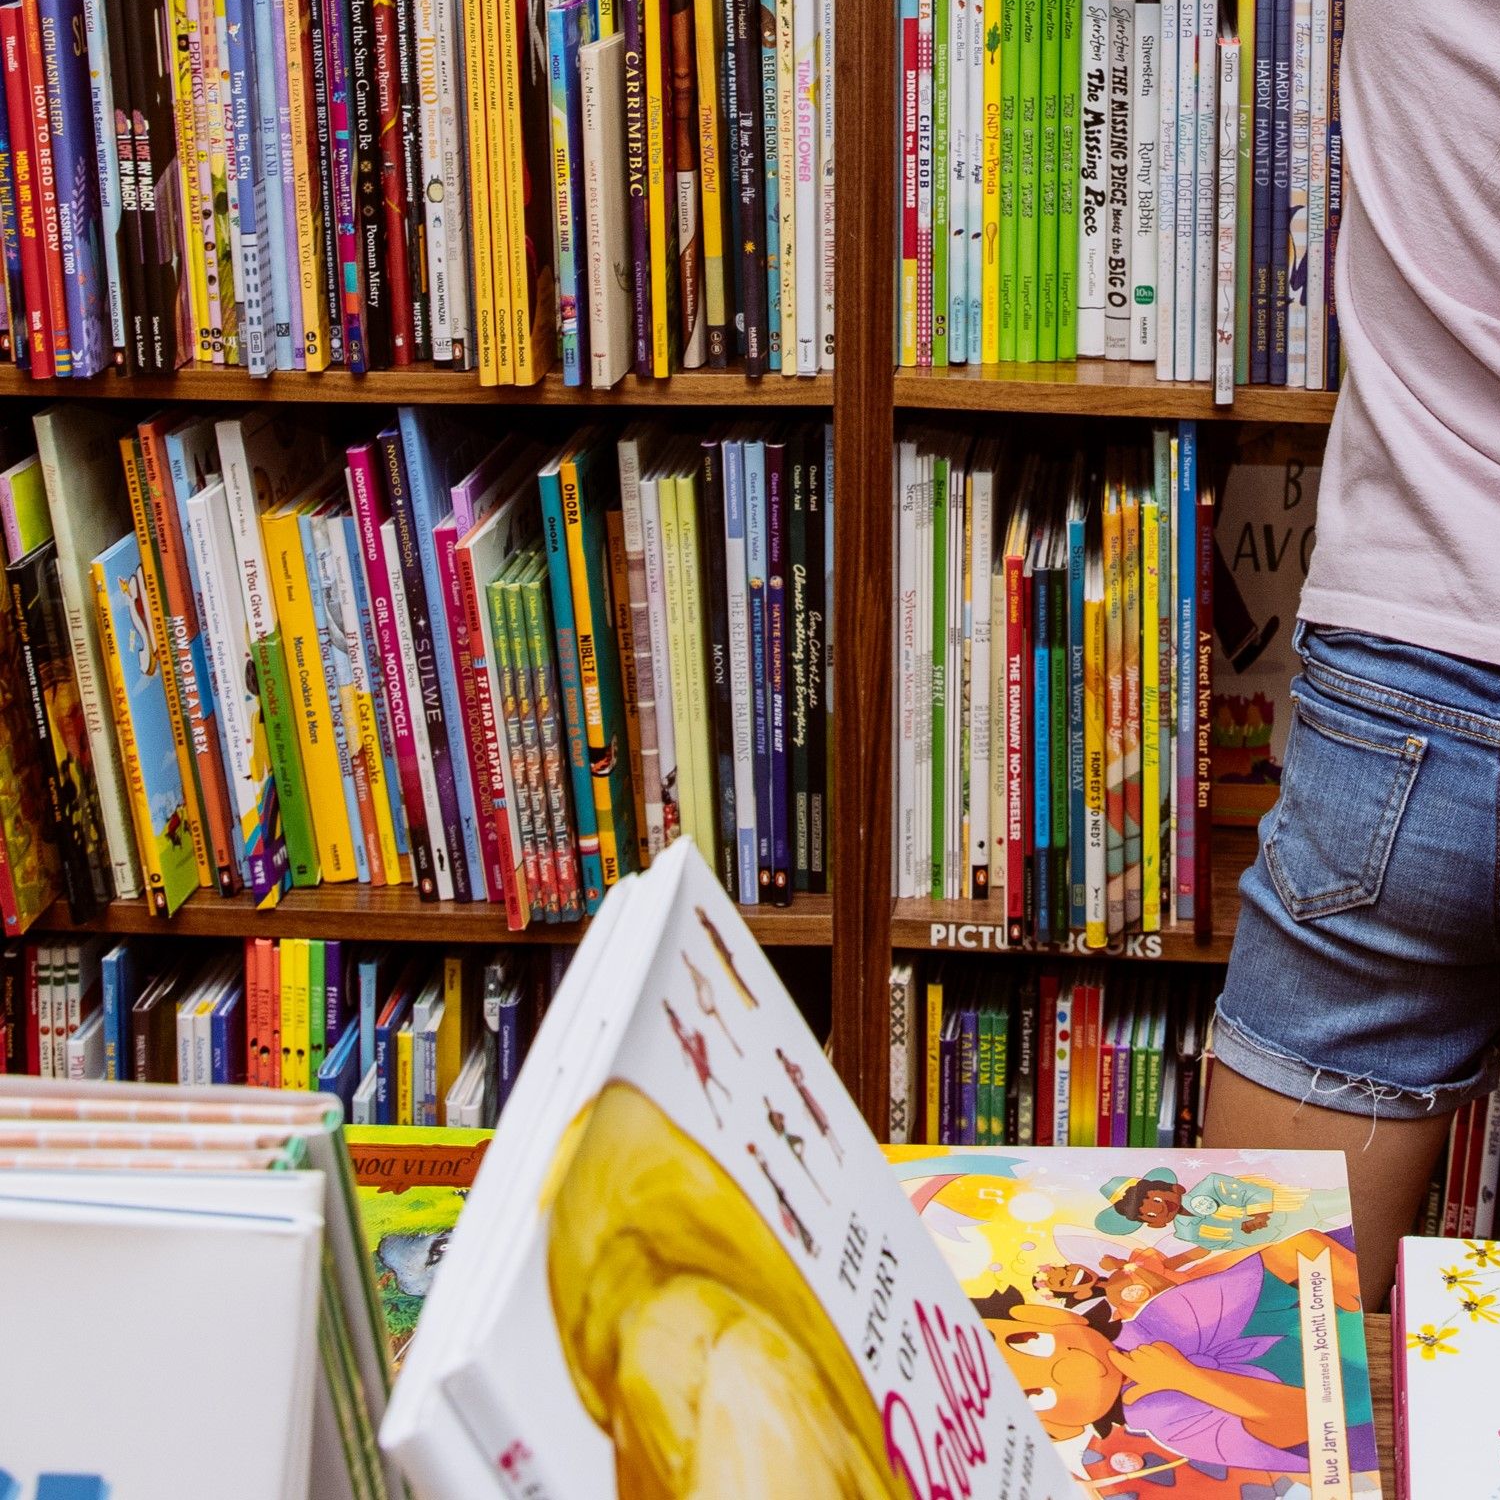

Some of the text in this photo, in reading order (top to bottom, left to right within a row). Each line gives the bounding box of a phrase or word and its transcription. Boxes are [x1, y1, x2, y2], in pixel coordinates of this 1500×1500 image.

[351, 23, 366, 39] the
[353, 41, 367, 75] Stars
[355, 77, 369, 115] Came
[357, 118, 369, 130] to
[625, 51, 644, 198] CARRIMEBAC
[1254, 59, 1272, 188] HARDLY HAUNTED
[358, 135, 370, 151] Be
[919, 114, 931, 189] CHEZ BOB
[1080, 69, 1106, 237] The Missing Piece
[416, 637, 443, 724] SULWE
[580, 633, 597, 677] NIBLET
[712, 643, 724, 685] MOON
[584, 685, 602, 726] RALPH
[1198, 631, 1212, 808] A Sweet New Year for Ren
[1006, 654, 1021, 842] THE RUNAWAY NO-WHEELER
[994, 1034, 1006, 1087] TATUM
[403, 1157, 472, 1177] JULIA
[838, 1211, 868, 1293] THE
[864, 1235, 899, 1371] STORY
[1309, 1271, 1327, 1311] Cornejo
[899, 1320, 919, 1383] OF
[1313, 1312, 1328, 1352] Xochitl
[882, 1299, 993, 1500] Barbie
[1321, 1421, 1341, 1486] Blue Jaryn
